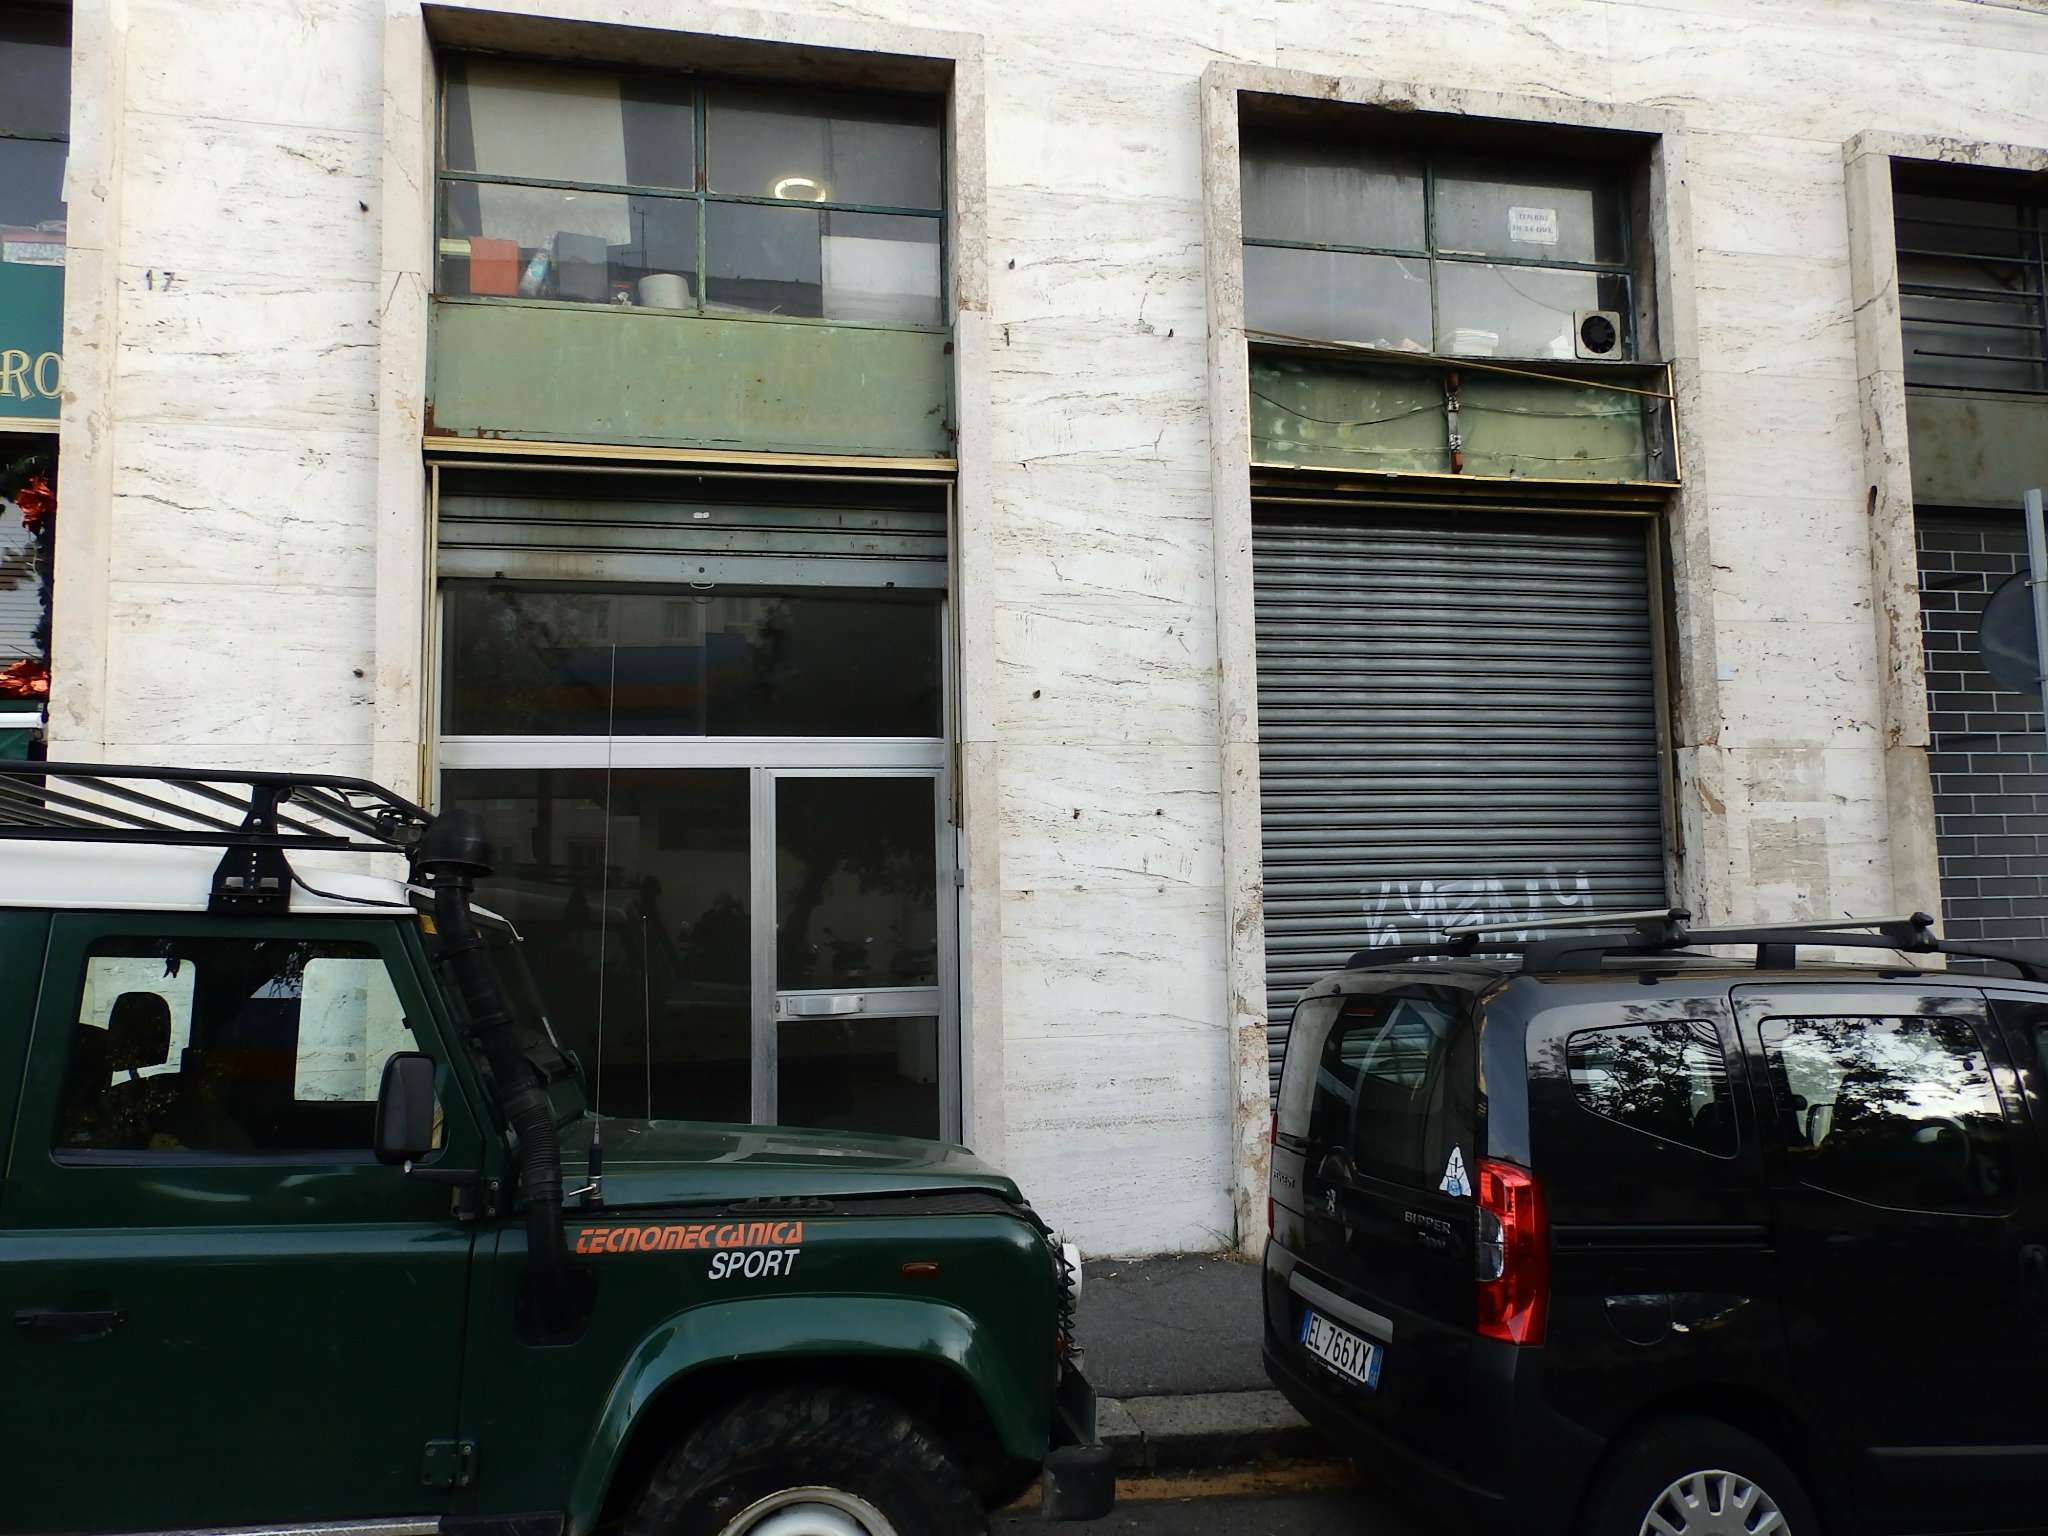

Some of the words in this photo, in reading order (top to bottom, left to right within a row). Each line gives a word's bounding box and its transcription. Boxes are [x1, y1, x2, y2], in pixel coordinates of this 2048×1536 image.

[146, 269, 175, 292] 17
[1404, 1210, 1451, 1235] BIPPER
[708, 1248, 800, 1280] SPORT
